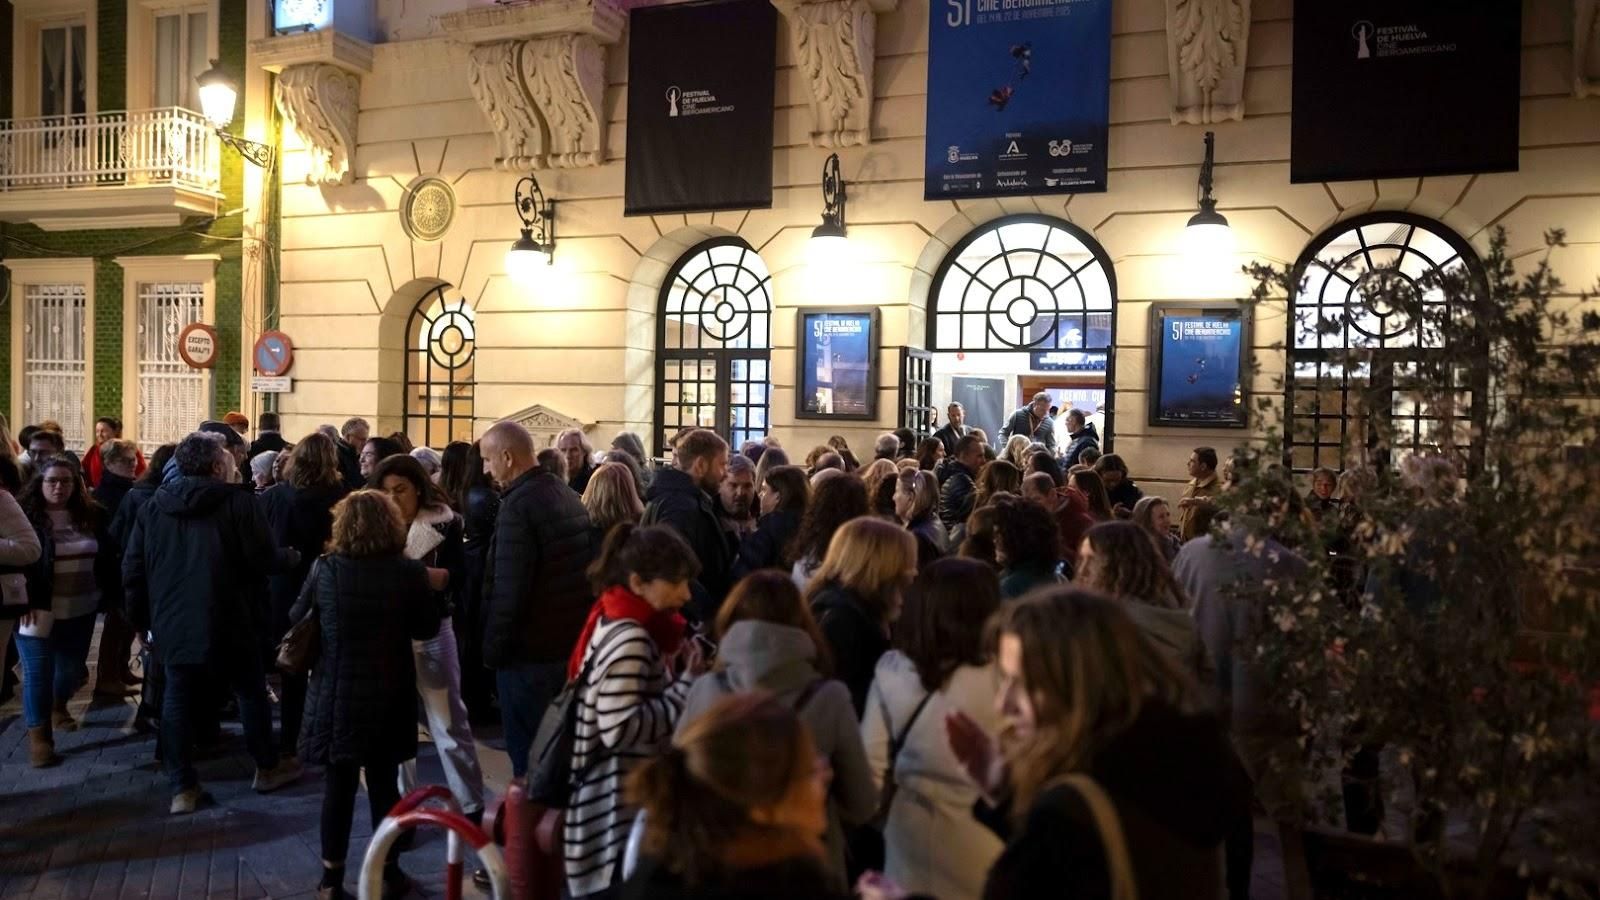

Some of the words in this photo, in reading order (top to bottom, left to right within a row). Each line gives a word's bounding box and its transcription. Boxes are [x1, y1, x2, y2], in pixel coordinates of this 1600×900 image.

[1377, 24, 1418, 34] FESTIVAL
[1377, 35, 1389, 43] DE
[1391, 31, 1428, 41] HUELVA
[1172, 321, 1183, 340] 51
[188, 336, 210, 344] EXCEPTO
